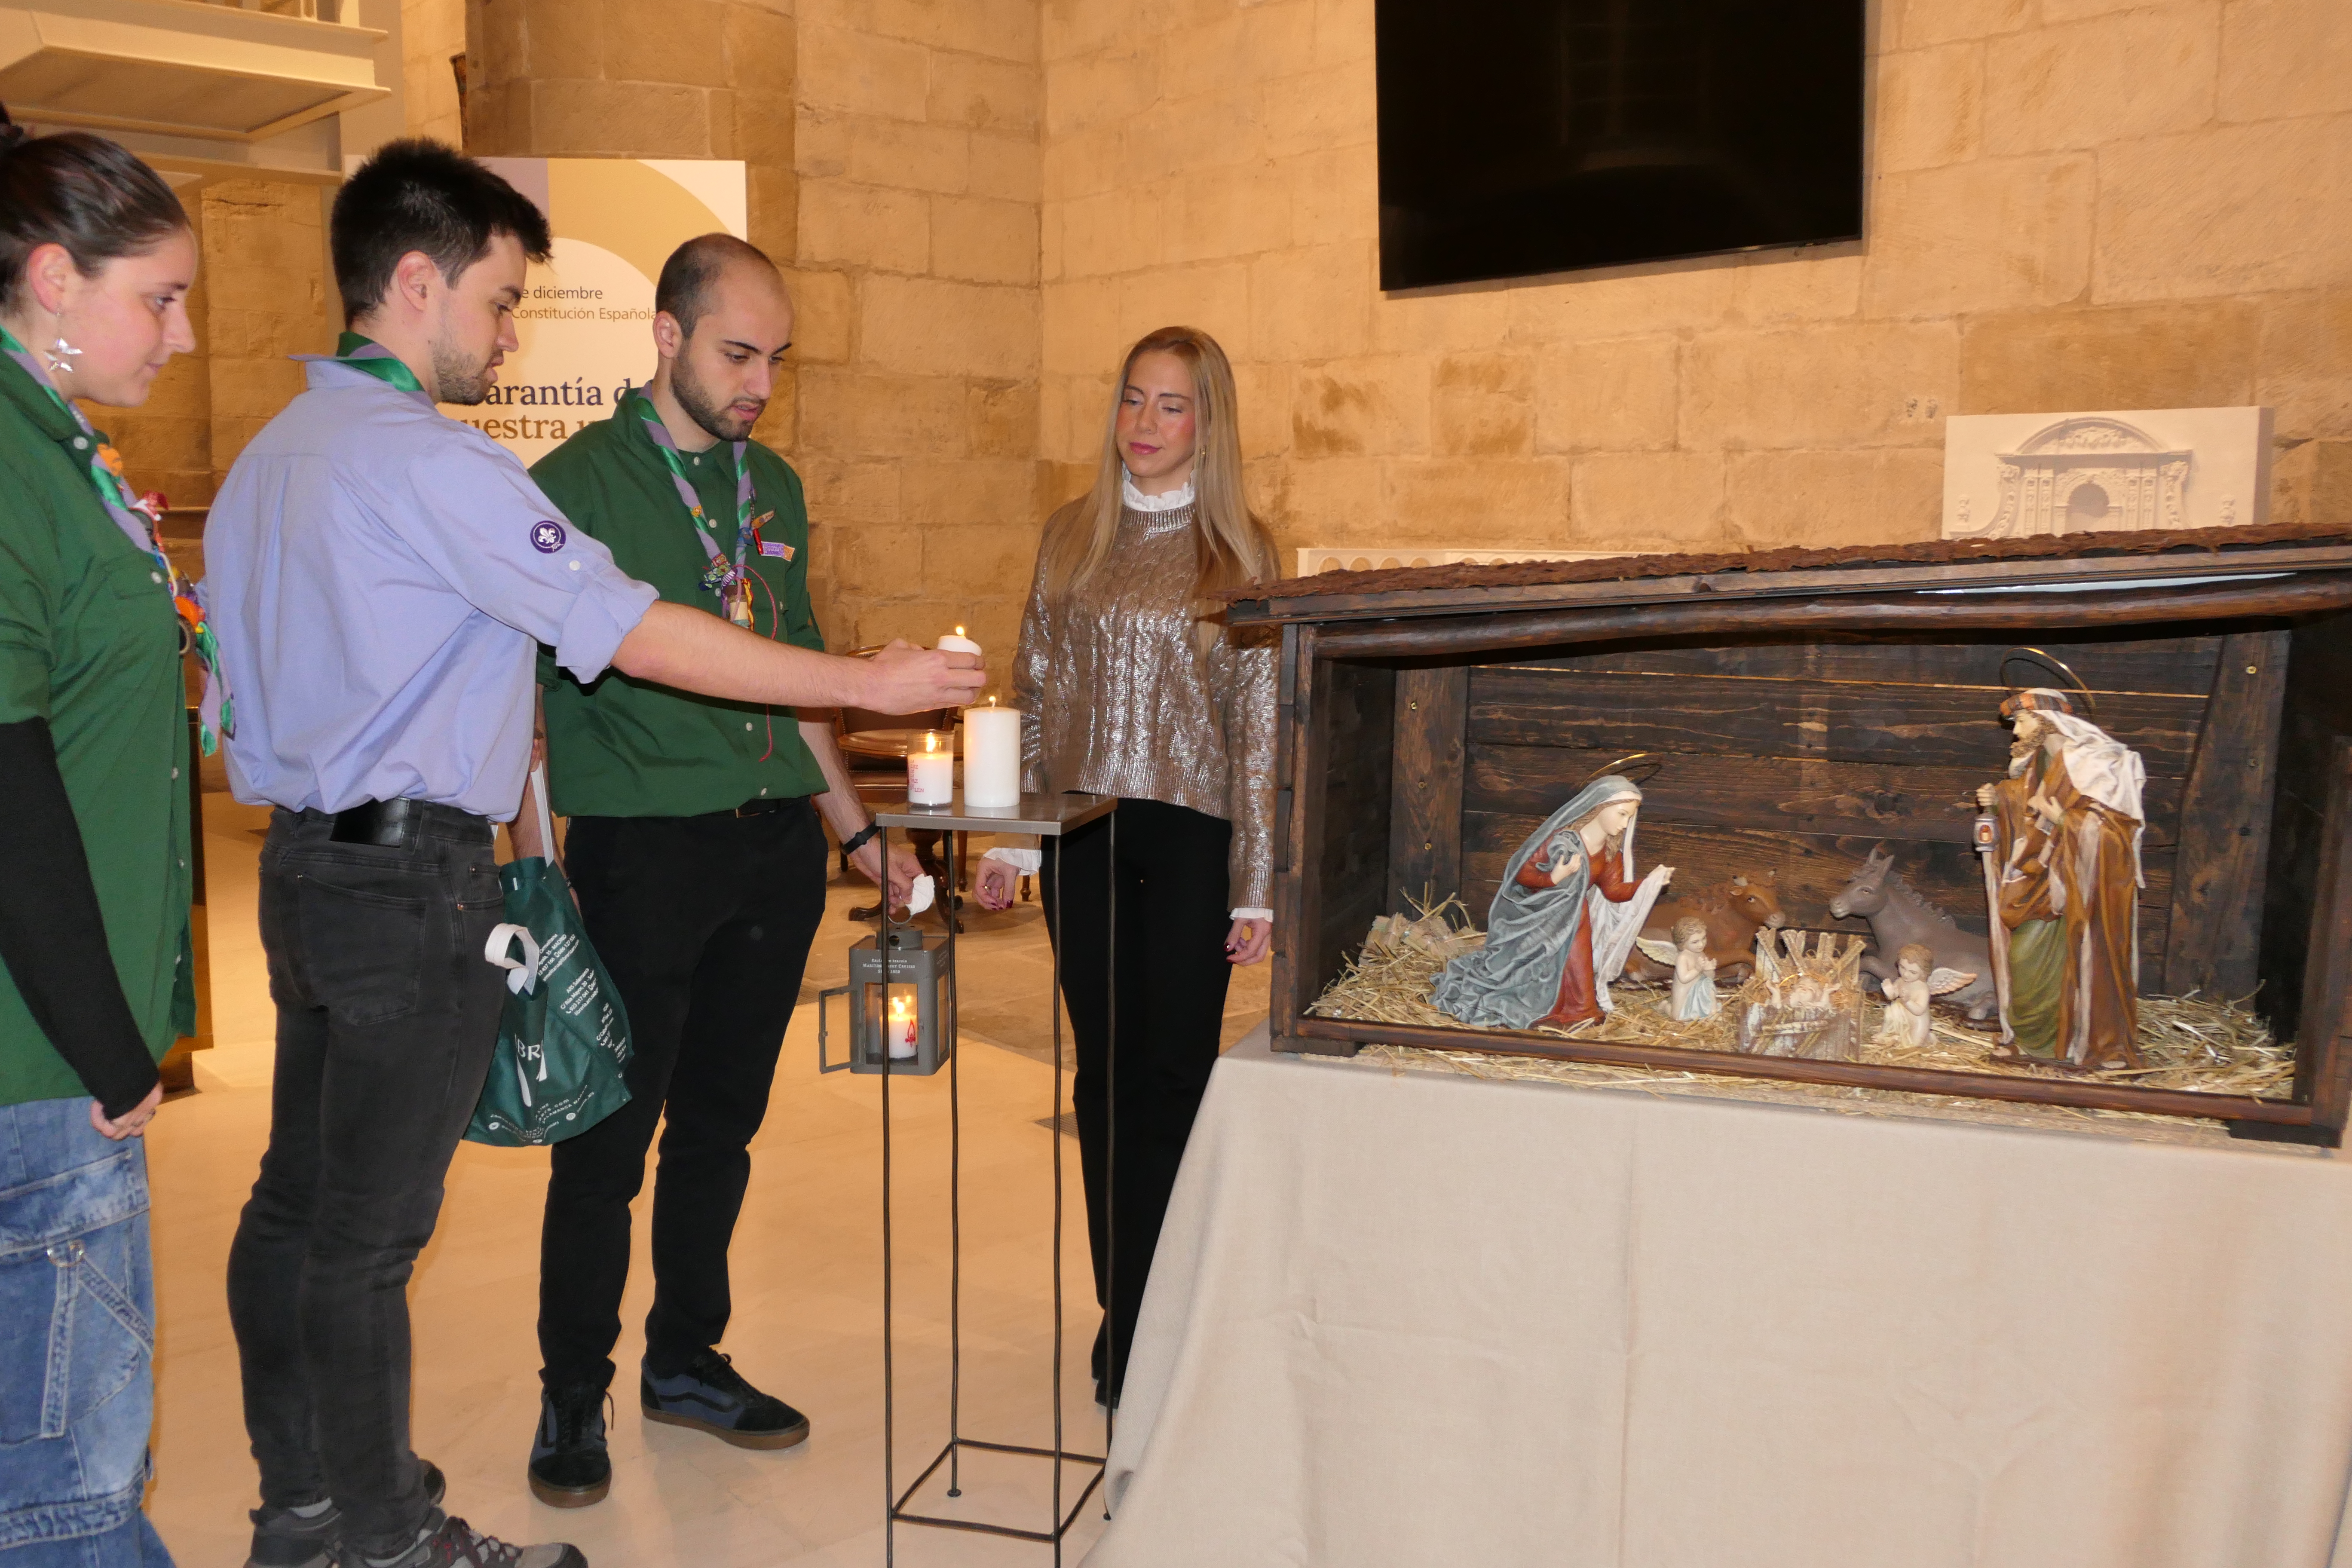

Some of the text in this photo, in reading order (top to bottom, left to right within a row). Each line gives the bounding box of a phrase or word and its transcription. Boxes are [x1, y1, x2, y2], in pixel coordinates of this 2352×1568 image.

[521, 286, 603, 300] e diciembre
[511, 306, 656, 322] Constitución Española
[484, 376, 603, 406] arantía
[551, 934, 567, 949] MADRID
[573, 968, 589, 986] Salamanca
[569, 1003, 577, 1011] 923
